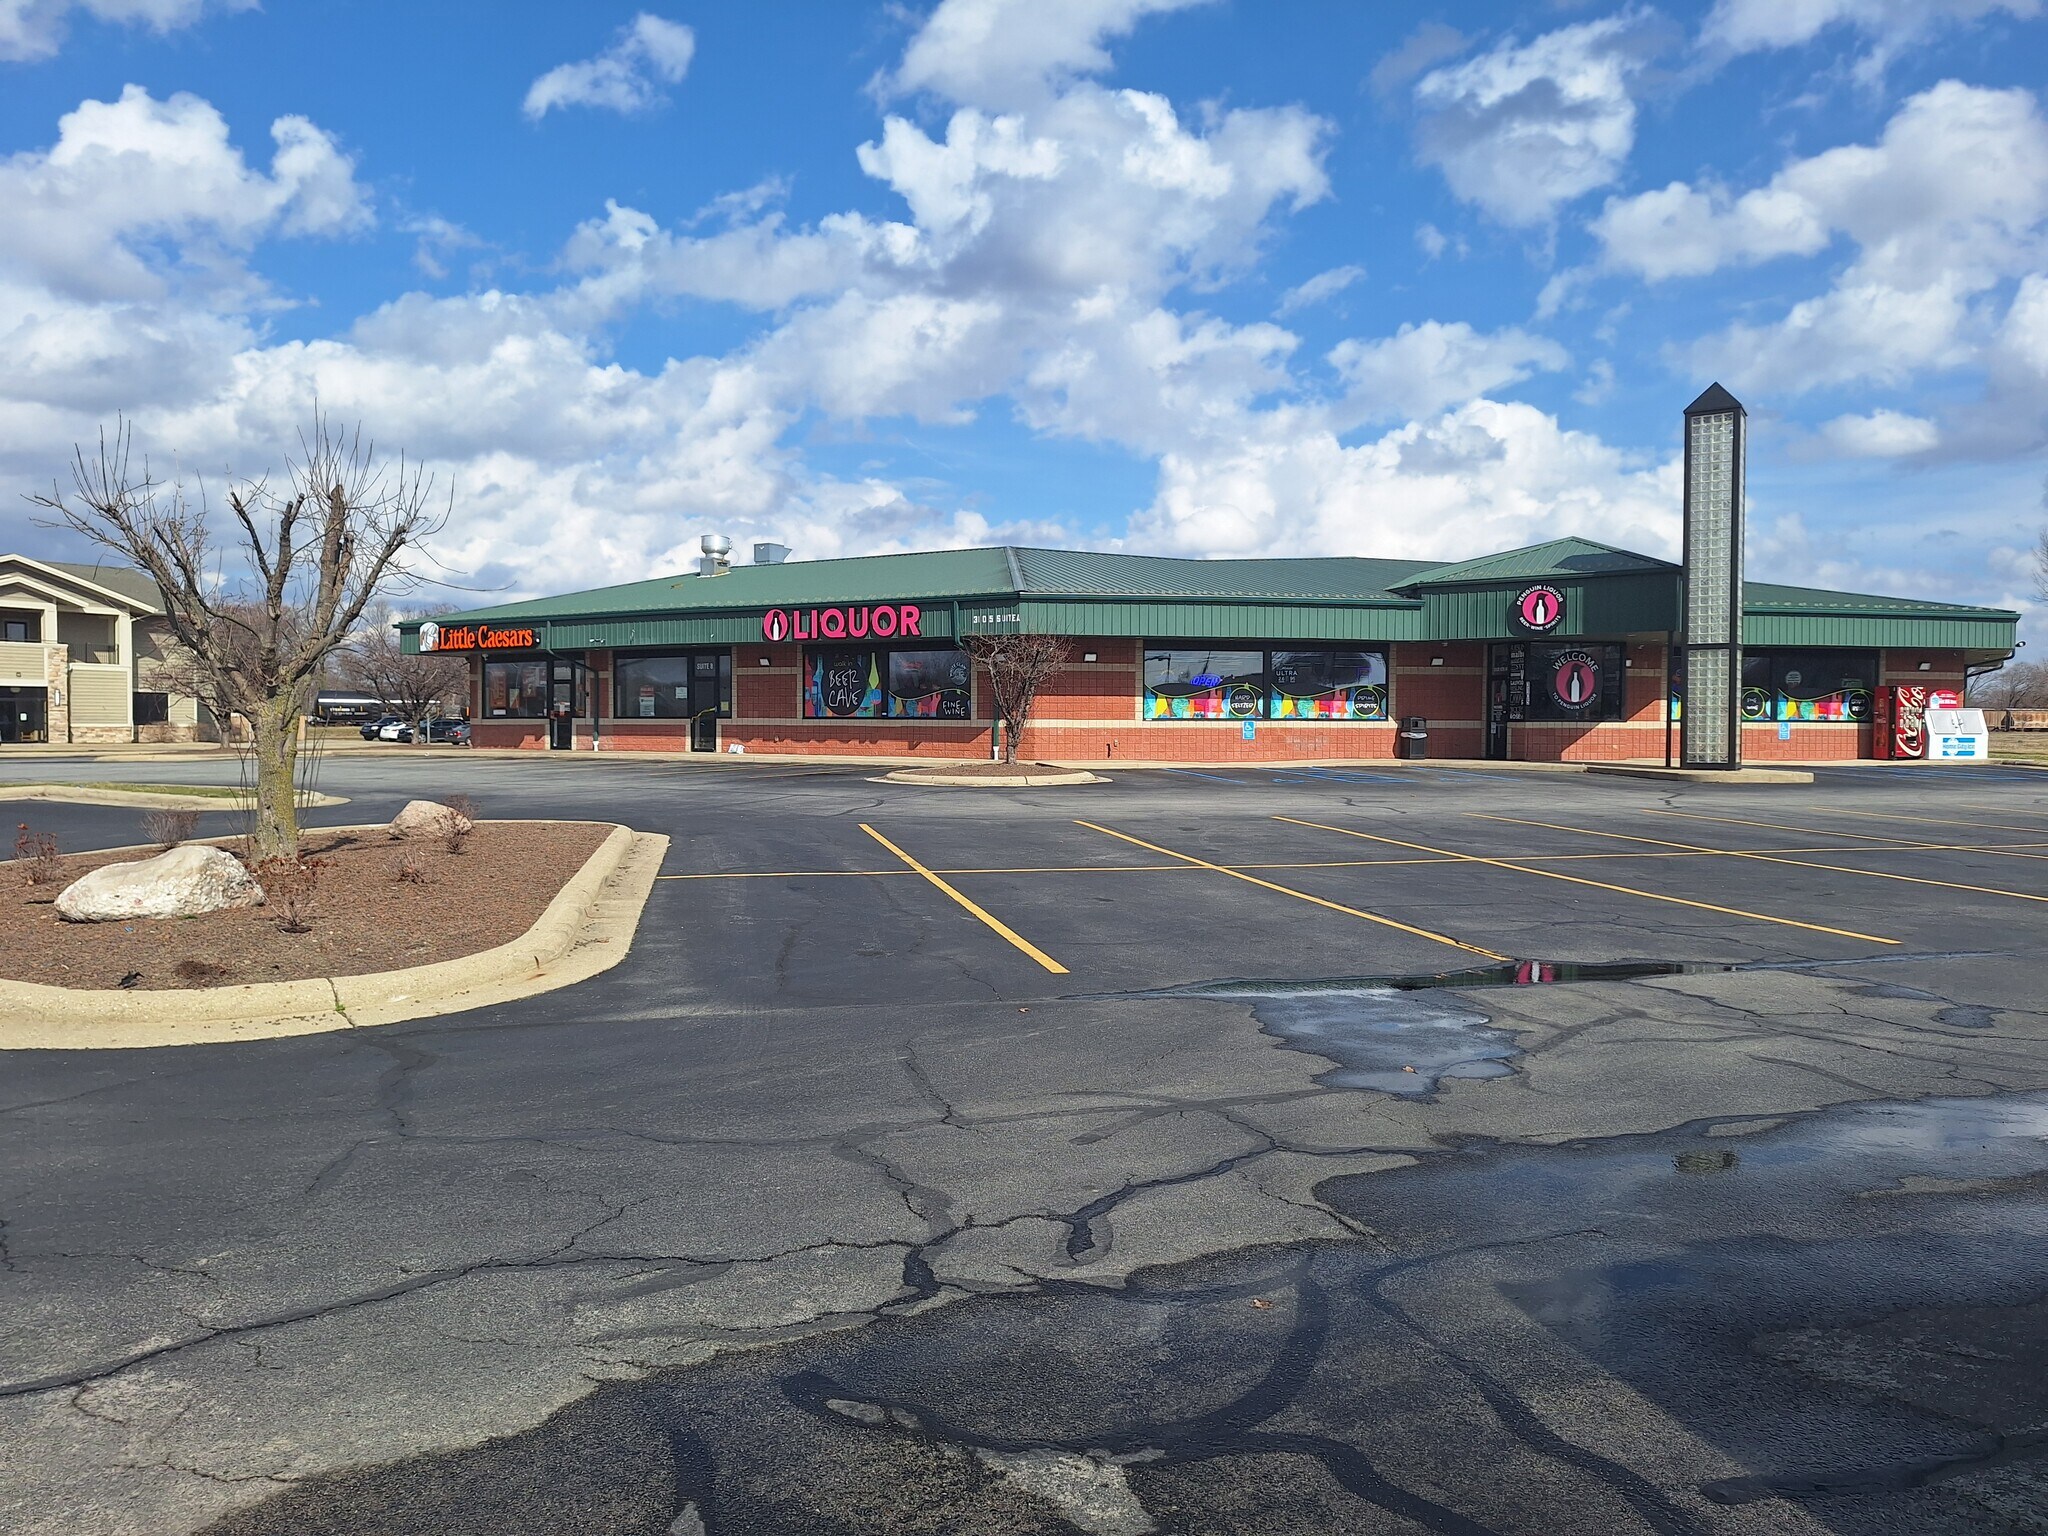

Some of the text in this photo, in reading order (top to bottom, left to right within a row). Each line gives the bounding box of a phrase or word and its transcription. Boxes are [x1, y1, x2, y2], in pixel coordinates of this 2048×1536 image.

[1516, 584, 1564, 606] PENGUIN LIQUOR
[793, 605, 920, 639] LIQUOR
[439, 625, 533, 650] Little Caesars
[696, 662, 709, 670] SUITE
[1552, 652, 1600, 673] WELCOME
[829, 668, 860, 690] BEER
[1192, 676, 1219, 687] OPEN
[829, 687, 862, 708] CAVE
[942, 699, 961, 709] FINE
[1557, 699, 1580, 710] PENGUIN
[1580, 693, 1597, 709] LIQUOR
[944, 706, 966, 717] WINE
